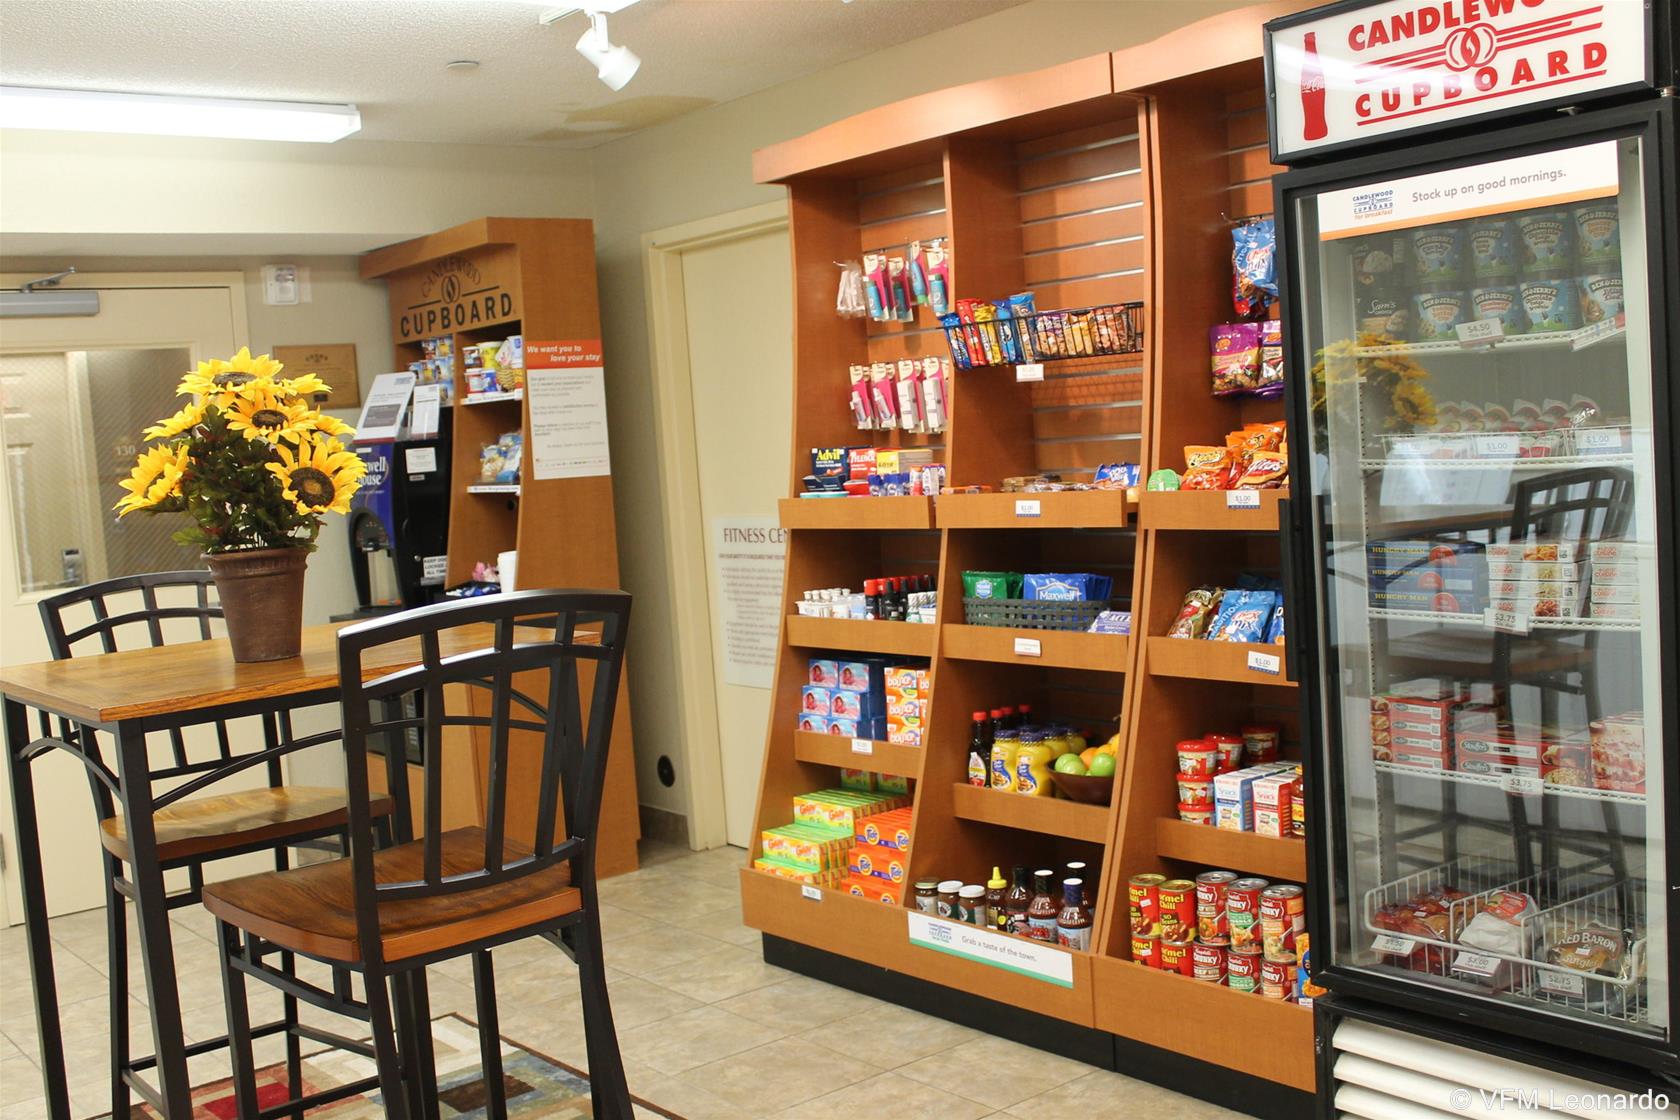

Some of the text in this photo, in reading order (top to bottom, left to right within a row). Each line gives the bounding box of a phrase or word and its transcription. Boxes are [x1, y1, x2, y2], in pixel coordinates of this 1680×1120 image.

[1348, 0, 1546, 51] CANDLEW
[1355, 43, 1607, 117] CUPBOARD
[1412, 168, 1567, 203] Stock up on good mornings.
[1352, 190, 1394, 201] CANDLEWOOD
[1354, 202, 1393, 213] CUPBOARD
[400, 292, 512, 337] CUPBOARD
[527, 344, 582, 354] We want you to
[550, 353, 601, 362] love your stay
[817, 449, 841, 461] Advil
[367, 456, 386, 472] well
[723, 527, 766, 544] FITNESS
[1039, 589, 1076, 601] Maxwell
[961, 936, 977, 946] Grab
[983, 941, 998, 952] taste
[1007, 948, 1017, 957] the
[1019, 951, 1037, 962] town.
[1558, 931, 1617, 953] RED BARON
